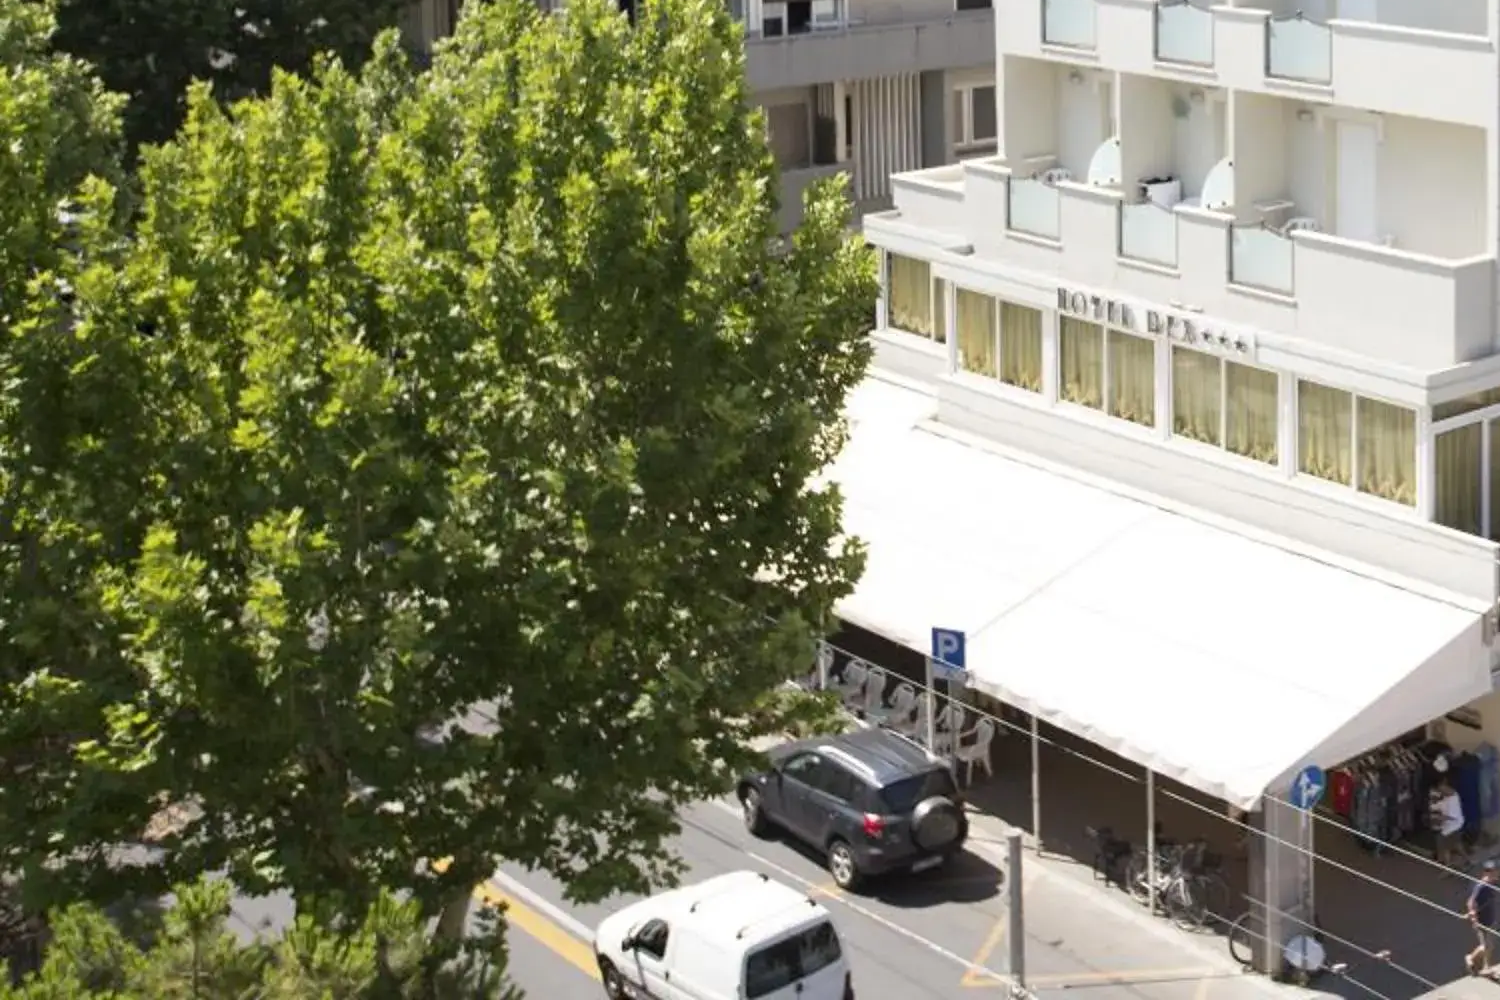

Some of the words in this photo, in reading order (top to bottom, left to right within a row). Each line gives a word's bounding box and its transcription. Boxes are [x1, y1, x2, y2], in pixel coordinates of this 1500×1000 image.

[1057, 287, 1136, 330] HOTEL
[1147, 310, 1197, 344] REX
[937, 631, 959, 661] P
